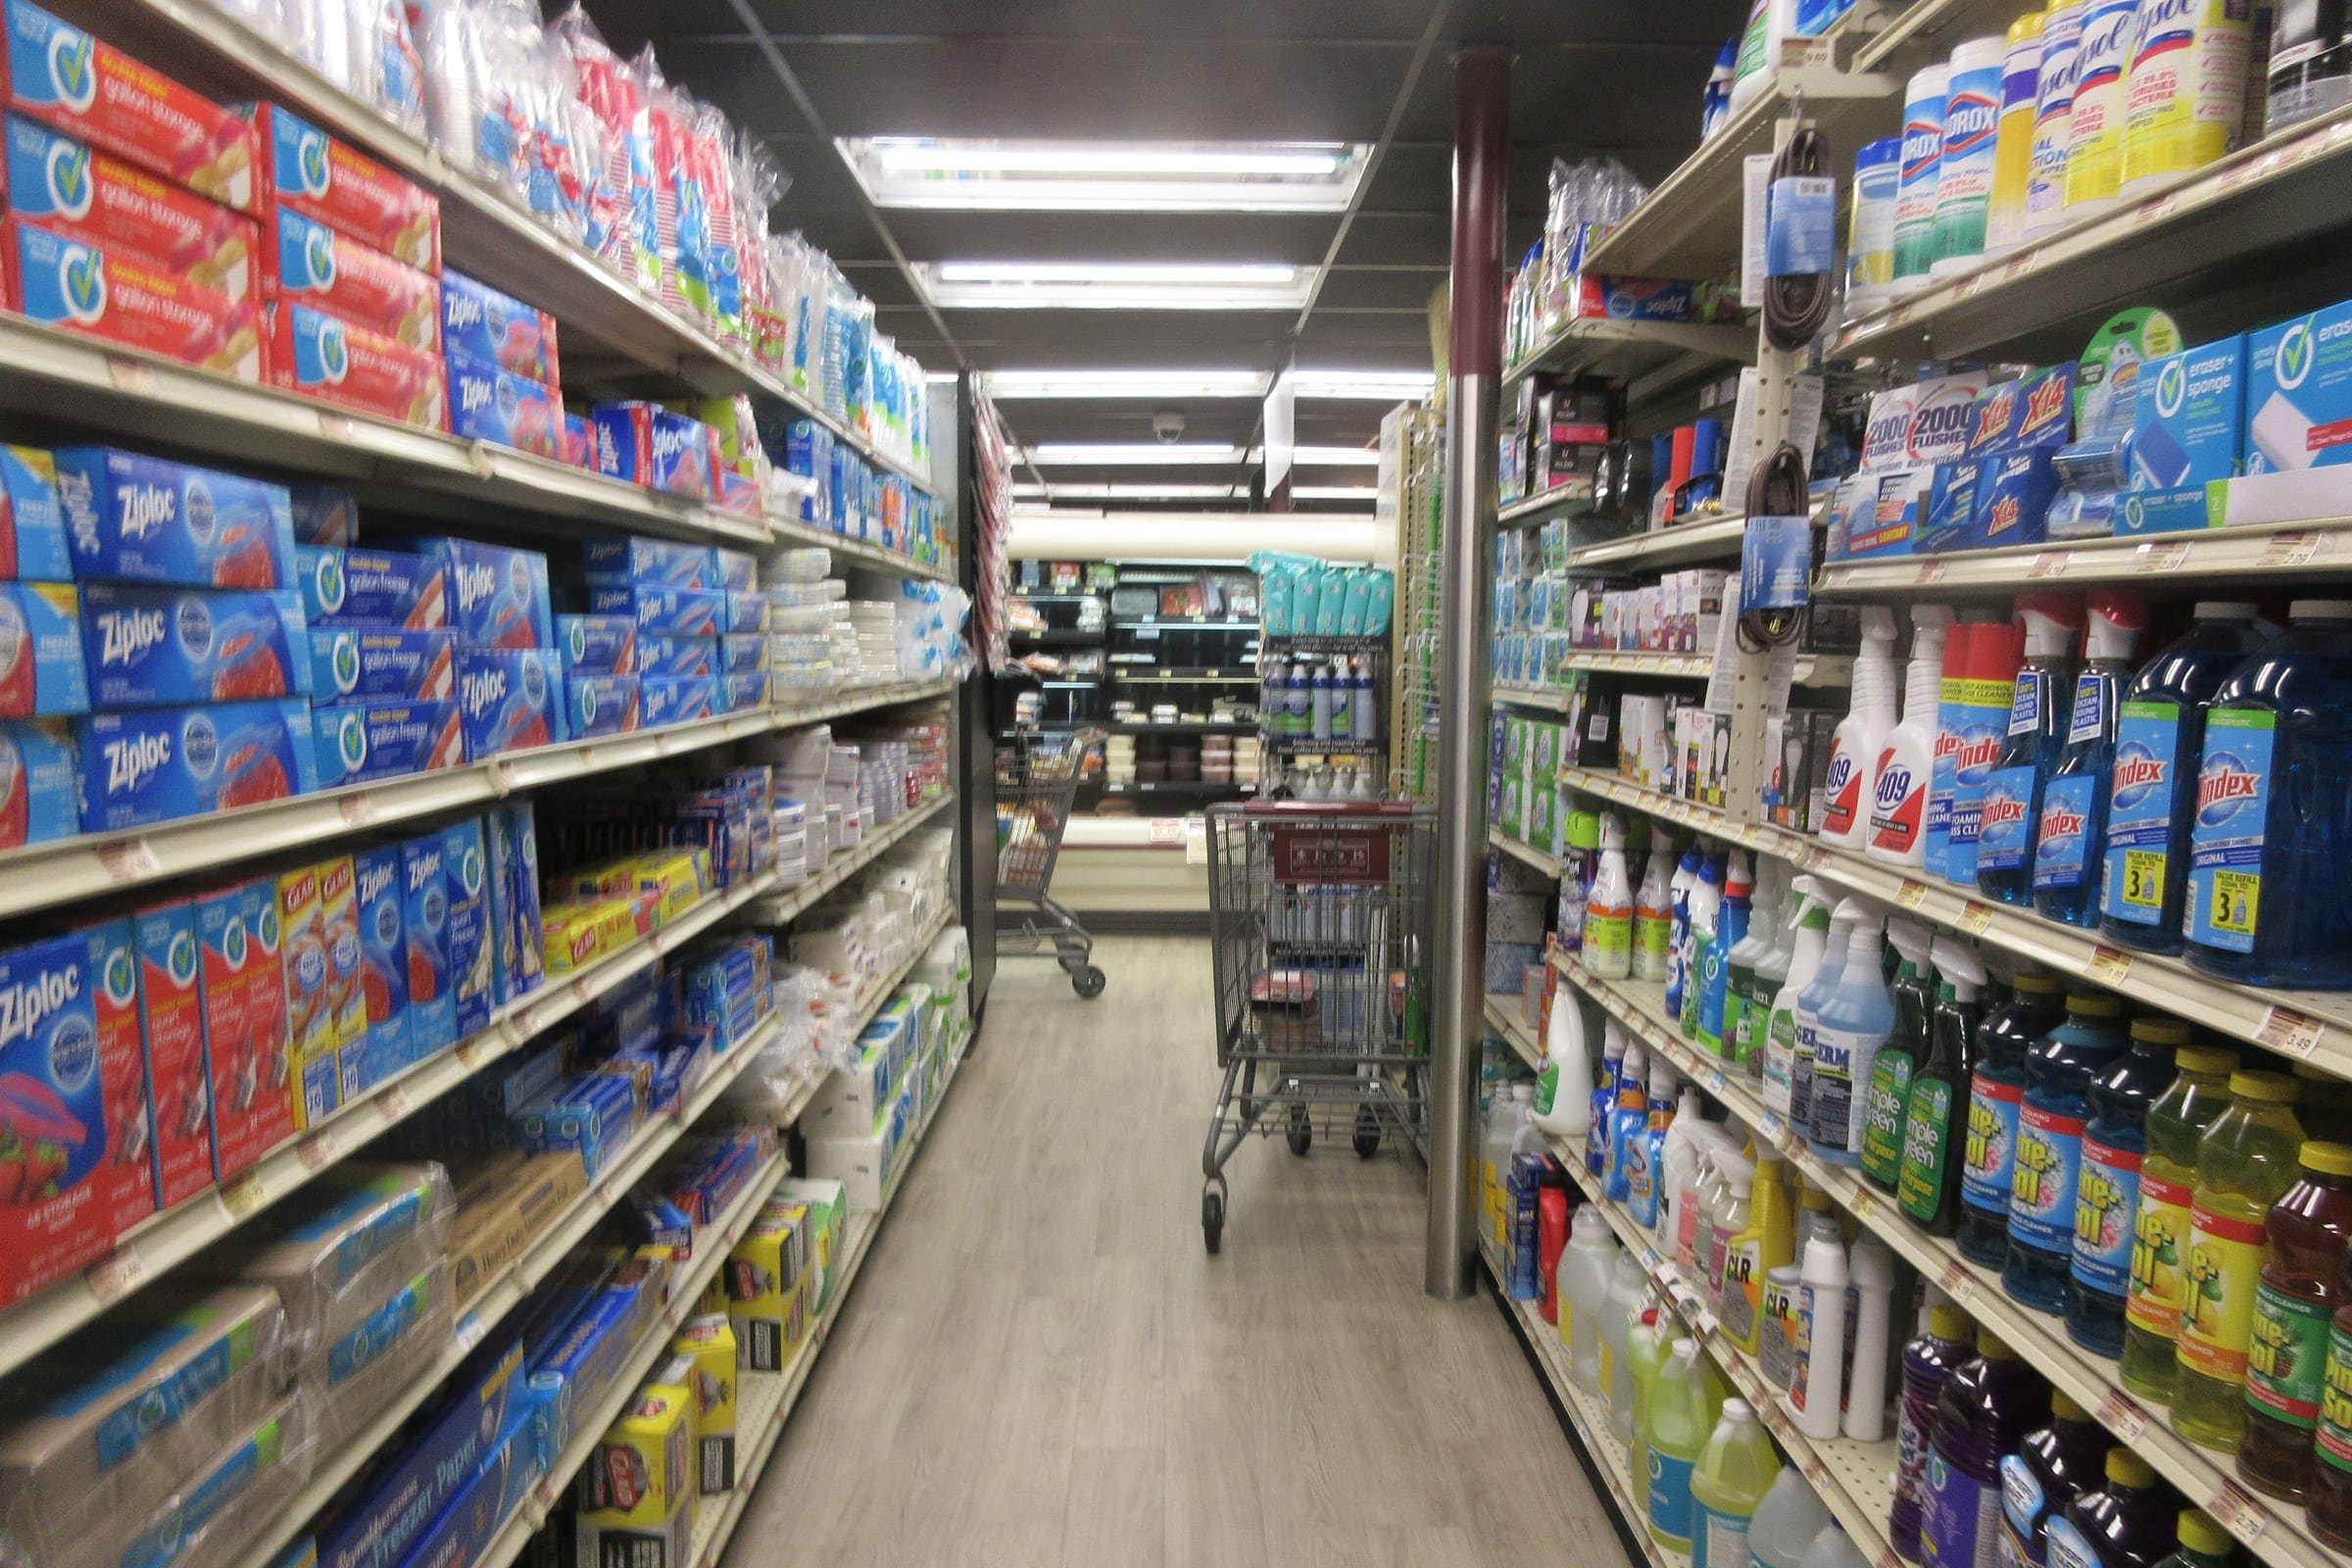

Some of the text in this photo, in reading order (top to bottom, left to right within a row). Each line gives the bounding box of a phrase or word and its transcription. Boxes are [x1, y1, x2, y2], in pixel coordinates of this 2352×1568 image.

[445, 292, 483, 328] Ziploc
[460, 374, 494, 412] Ziploc
[2187, 372, 2231, 399] sponge
[1870, 414, 1909, 445] 2000
[1866, 440, 1906, 458] FLUSHES
[118, 482, 176, 539] Ziploc
[98, 608, 166, 667] Ziploc
[104, 730, 172, 795] Ziploc
[2114, 757, 2163, 792] index
[1877, 771, 1911, 803] 409
[1981, 796, 2026, 828] index
[2039, 809, 2085, 843] index
[322, 865, 350, 895] GLAD
[361, 862, 394, 906] Ziploc
[409, 851, 441, 894] Ziploc
[2129, 869, 2140, 898] 3
[2216, 871, 2258, 886] VALUE REFILL
[287, 879, 315, 909] GLAD
[2218, 893, 2231, 922] 3
[573, 927, 595, 963] GLAD
[0, 964, 79, 1050] Ziploc
[2286, 1034, 2310, 1051] 3.49
[1728, 1254, 1751, 1285] CLR
[1766, 1293, 1789, 1320] CLR
